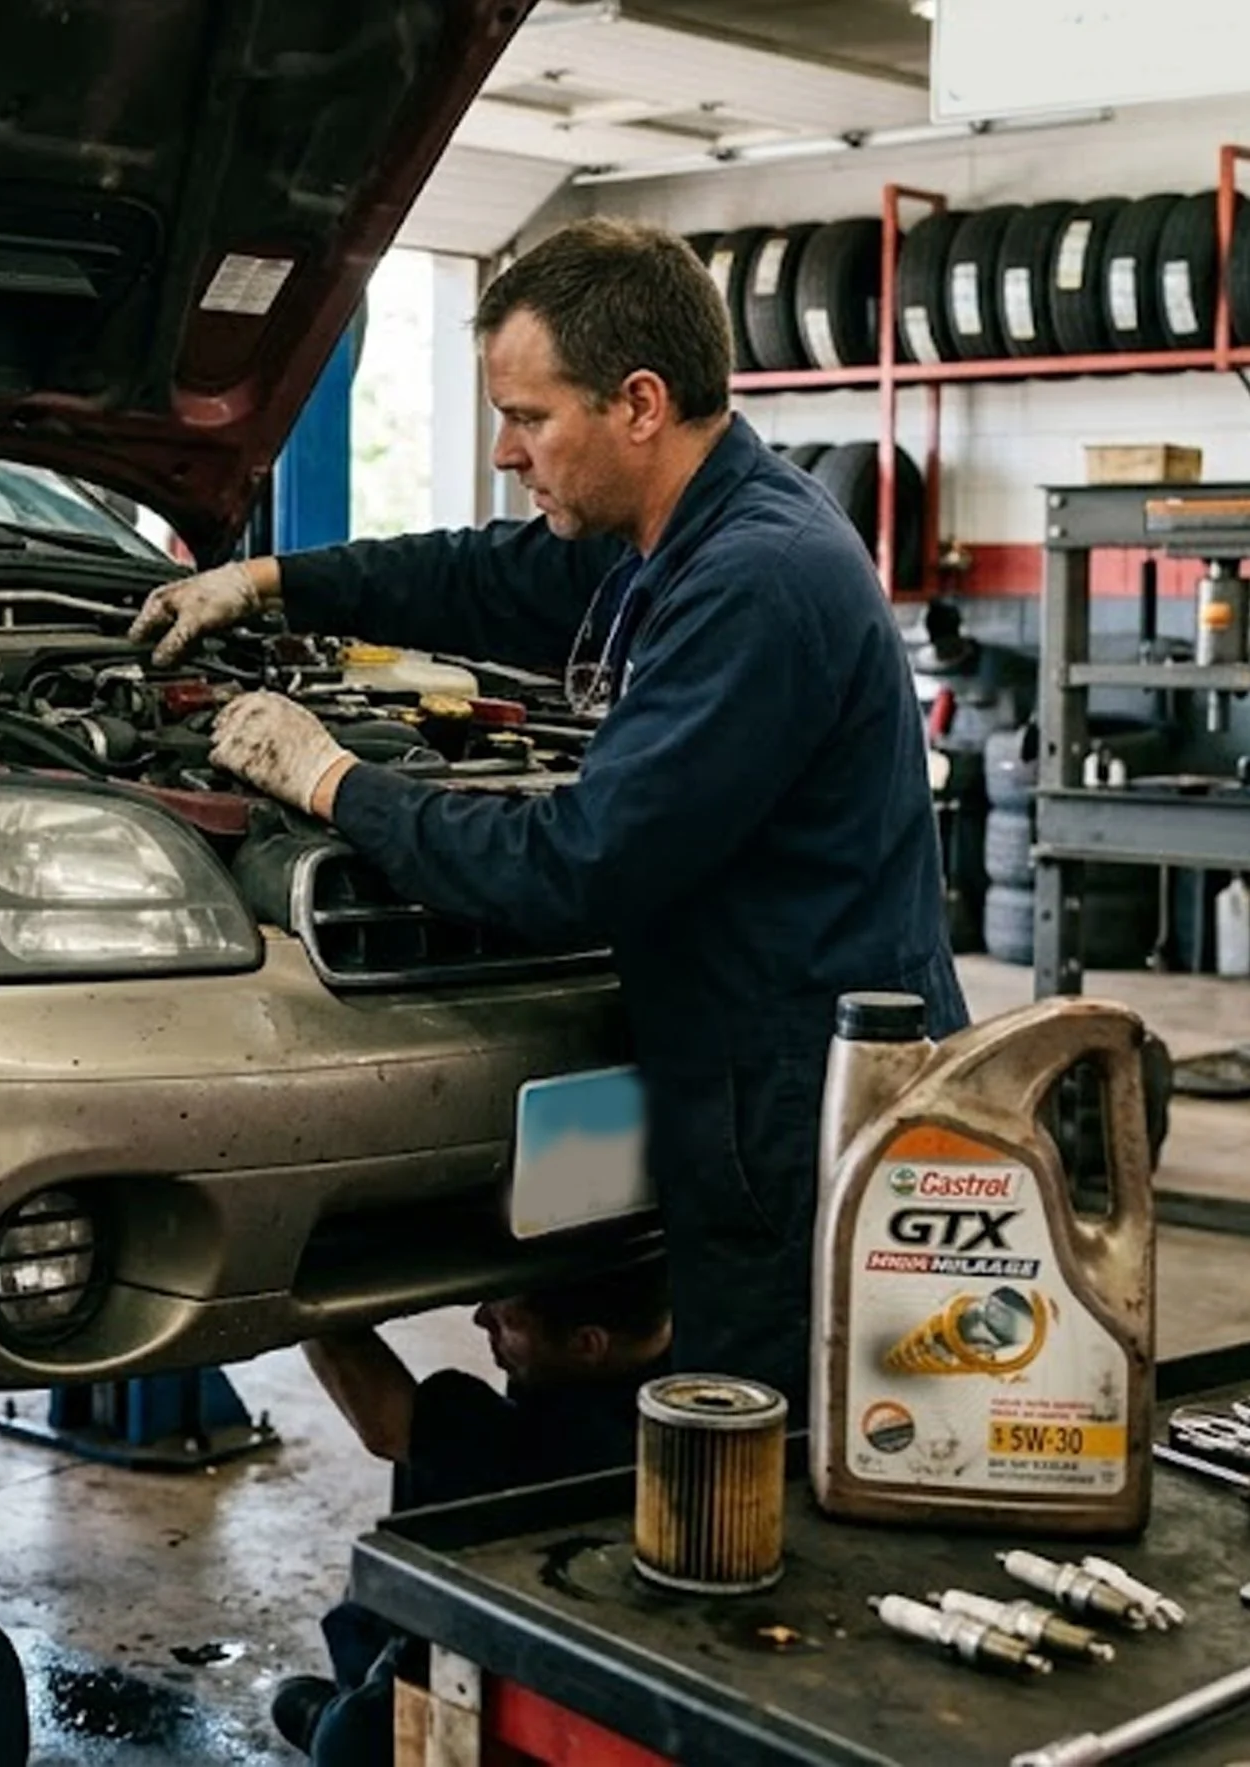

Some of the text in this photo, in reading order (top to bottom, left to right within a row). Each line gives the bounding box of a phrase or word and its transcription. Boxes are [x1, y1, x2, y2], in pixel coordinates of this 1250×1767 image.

[920, 1171, 1012, 1197] Castrol
[888, 1208, 1025, 1252] GTX
[1010, 1425, 1084, 1454] 5W-30
